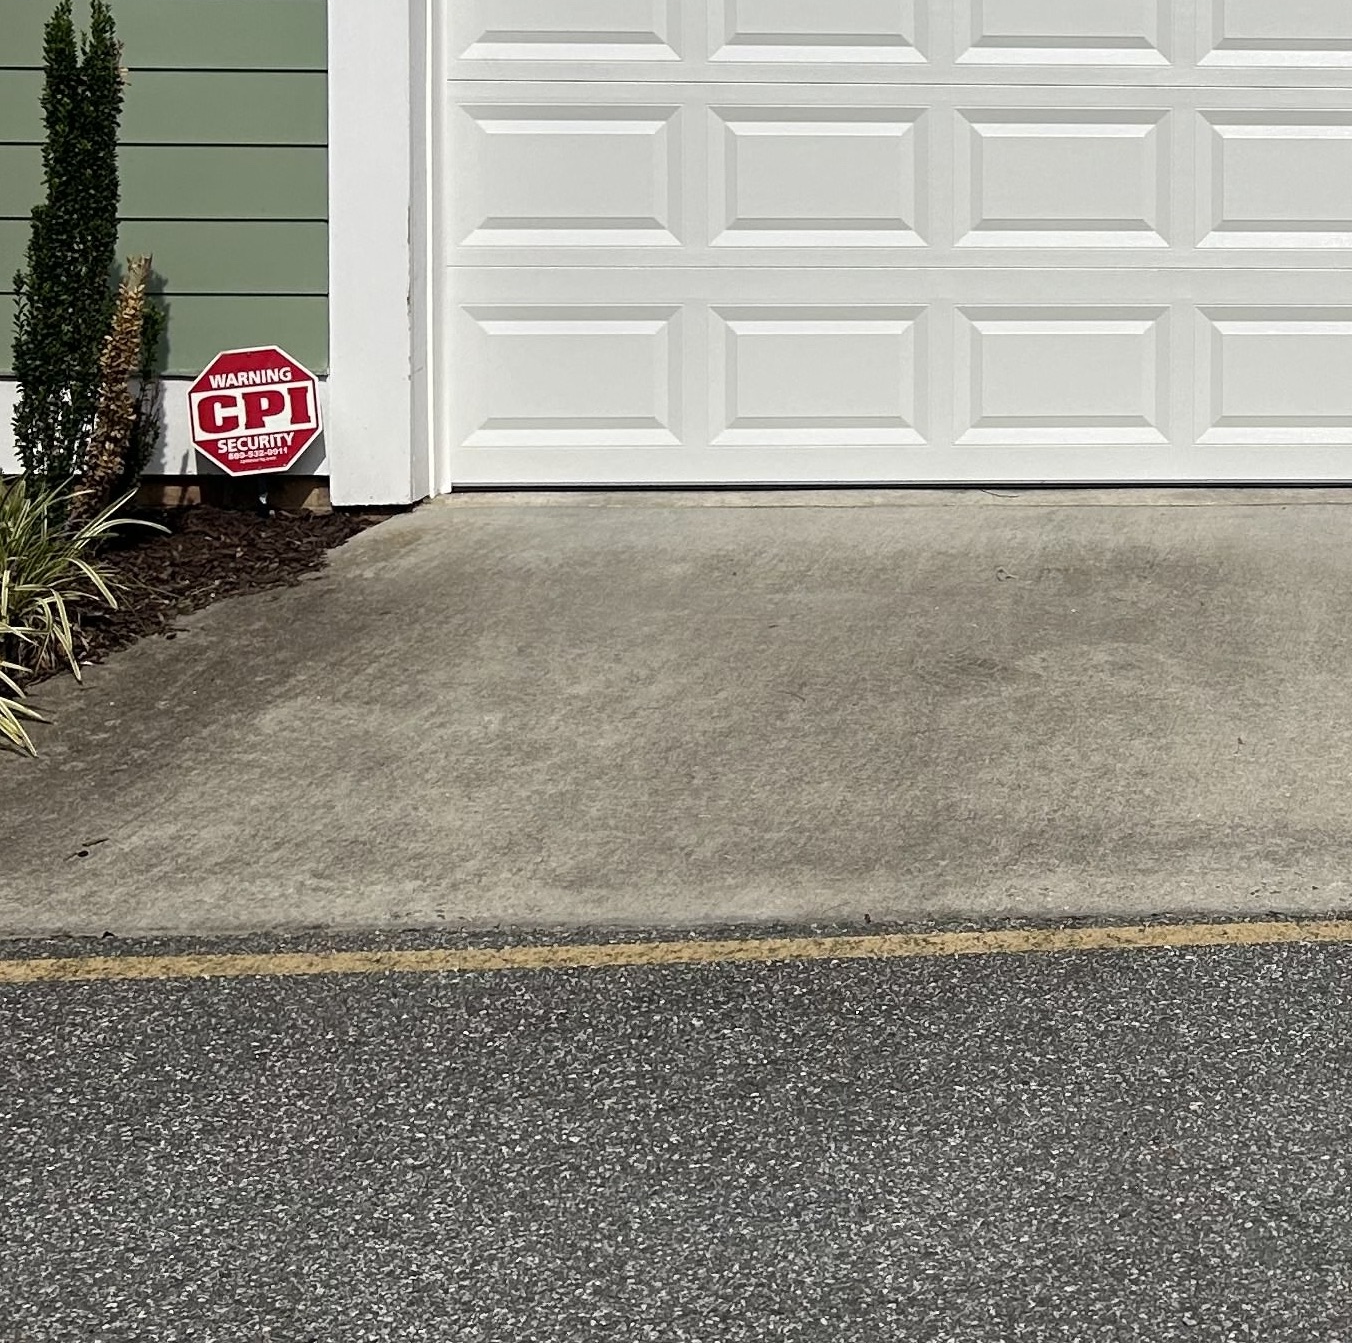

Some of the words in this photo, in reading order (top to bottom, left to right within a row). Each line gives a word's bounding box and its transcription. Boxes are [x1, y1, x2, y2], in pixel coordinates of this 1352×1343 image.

[209, 367, 292, 389] WARNING
[197, 386, 311, 434] CPI
[217, 432, 295, 454] SECURITY
